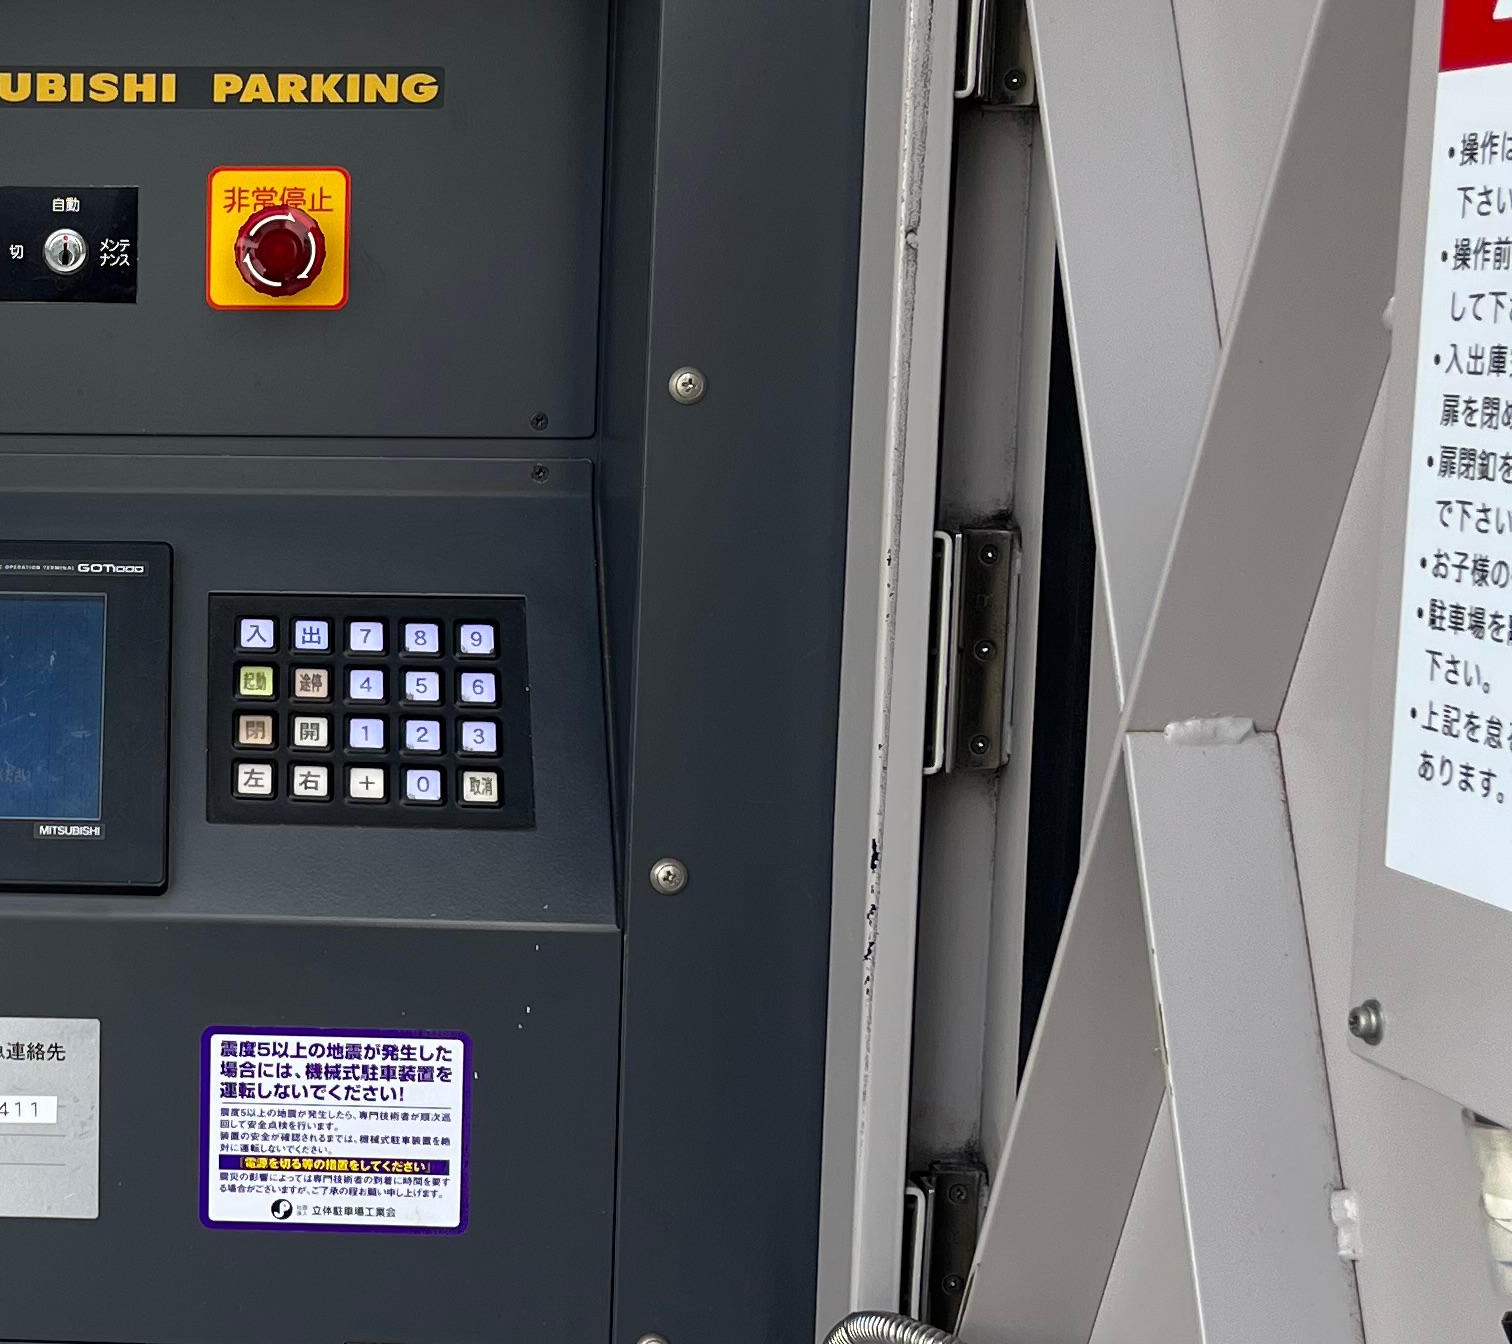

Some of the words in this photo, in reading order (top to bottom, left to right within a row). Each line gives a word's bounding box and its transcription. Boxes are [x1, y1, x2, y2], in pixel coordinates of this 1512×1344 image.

[213, 72, 440, 104] PARKING
[51, 197, 81, 213] 自動
[223, 186, 334, 213] 非常停止
[9, 244, 25, 260] 切
[246, 625, 267, 643] 入
[302, 626, 321, 645] 出
[359, 629, 372, 644] 7
[414, 630, 427, 645] 8
[470, 631, 483, 646] 9
[1425, 649, 1491, 694] 下さい。
[243, 672, 267, 691] 起動
[299, 673, 323, 693] 途停
[359, 677, 372, 691] 4
[415, 678, 427, 693] 5
[472, 679, 484, 695] 6
[246, 721, 265, 740] 閉
[300, 722, 320, 741] 開
[361, 726, 369, 741] 1
[416, 728, 428, 742] 2
[473, 729, 485, 744] 3
[243, 769, 265, 788] 左
[299, 771, 320, 791] 右
[417, 777, 430, 792] 0
[469, 777, 493, 796] 取消
[1418, 749, 1505, 804] あります。
[39, 825, 101, 837] MITSUBISHI
[220, 1040, 453, 1062] 震度5以上の地震が発生した
[219, 1061, 453, 1082] 場合には、機械式駐車装置を
[219, 1082, 404, 1102] 運転しないでください!
